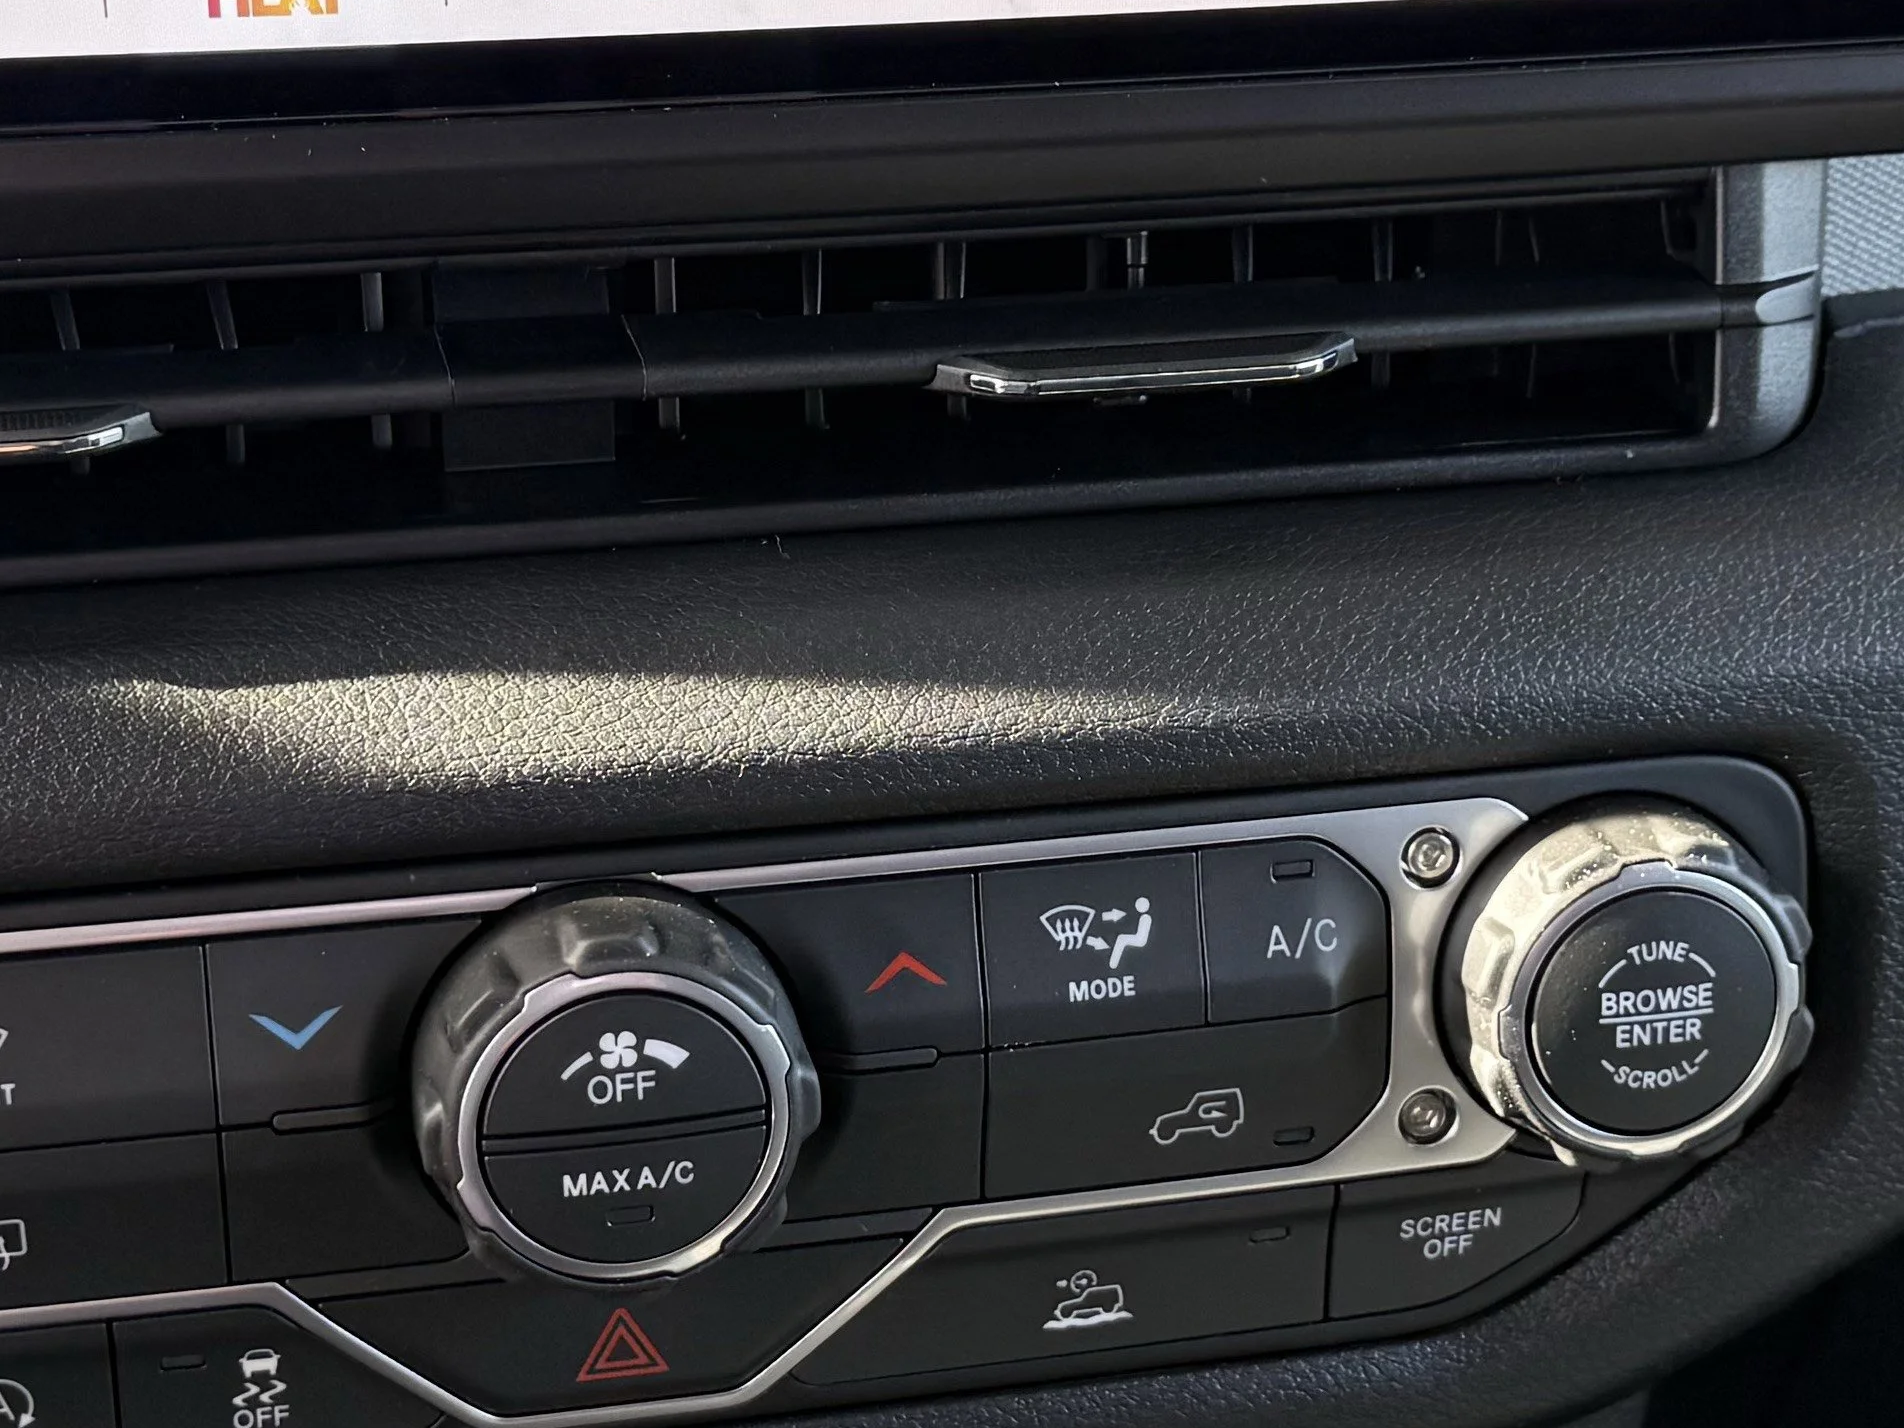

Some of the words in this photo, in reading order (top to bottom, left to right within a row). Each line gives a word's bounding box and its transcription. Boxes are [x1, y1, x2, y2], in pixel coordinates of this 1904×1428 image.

[1264, 915, 1338, 960] A/C
[1626, 938, 1688, 971] TUNE
[1066, 971, 1138, 1005] MODE
[1598, 980, 1716, 1018] BROWSE
[1614, 1013, 1704, 1048] ENTER
[585, 1066, 658, 1107] OFF
[1613, 1059, 1703, 1092] SCROLL
[560, 1164, 632, 1200] MAX
[635, 1158, 696, 1197] A/C
[1398, 1205, 1503, 1243] SCREEN
[1423, 1229, 1476, 1260] OFF
